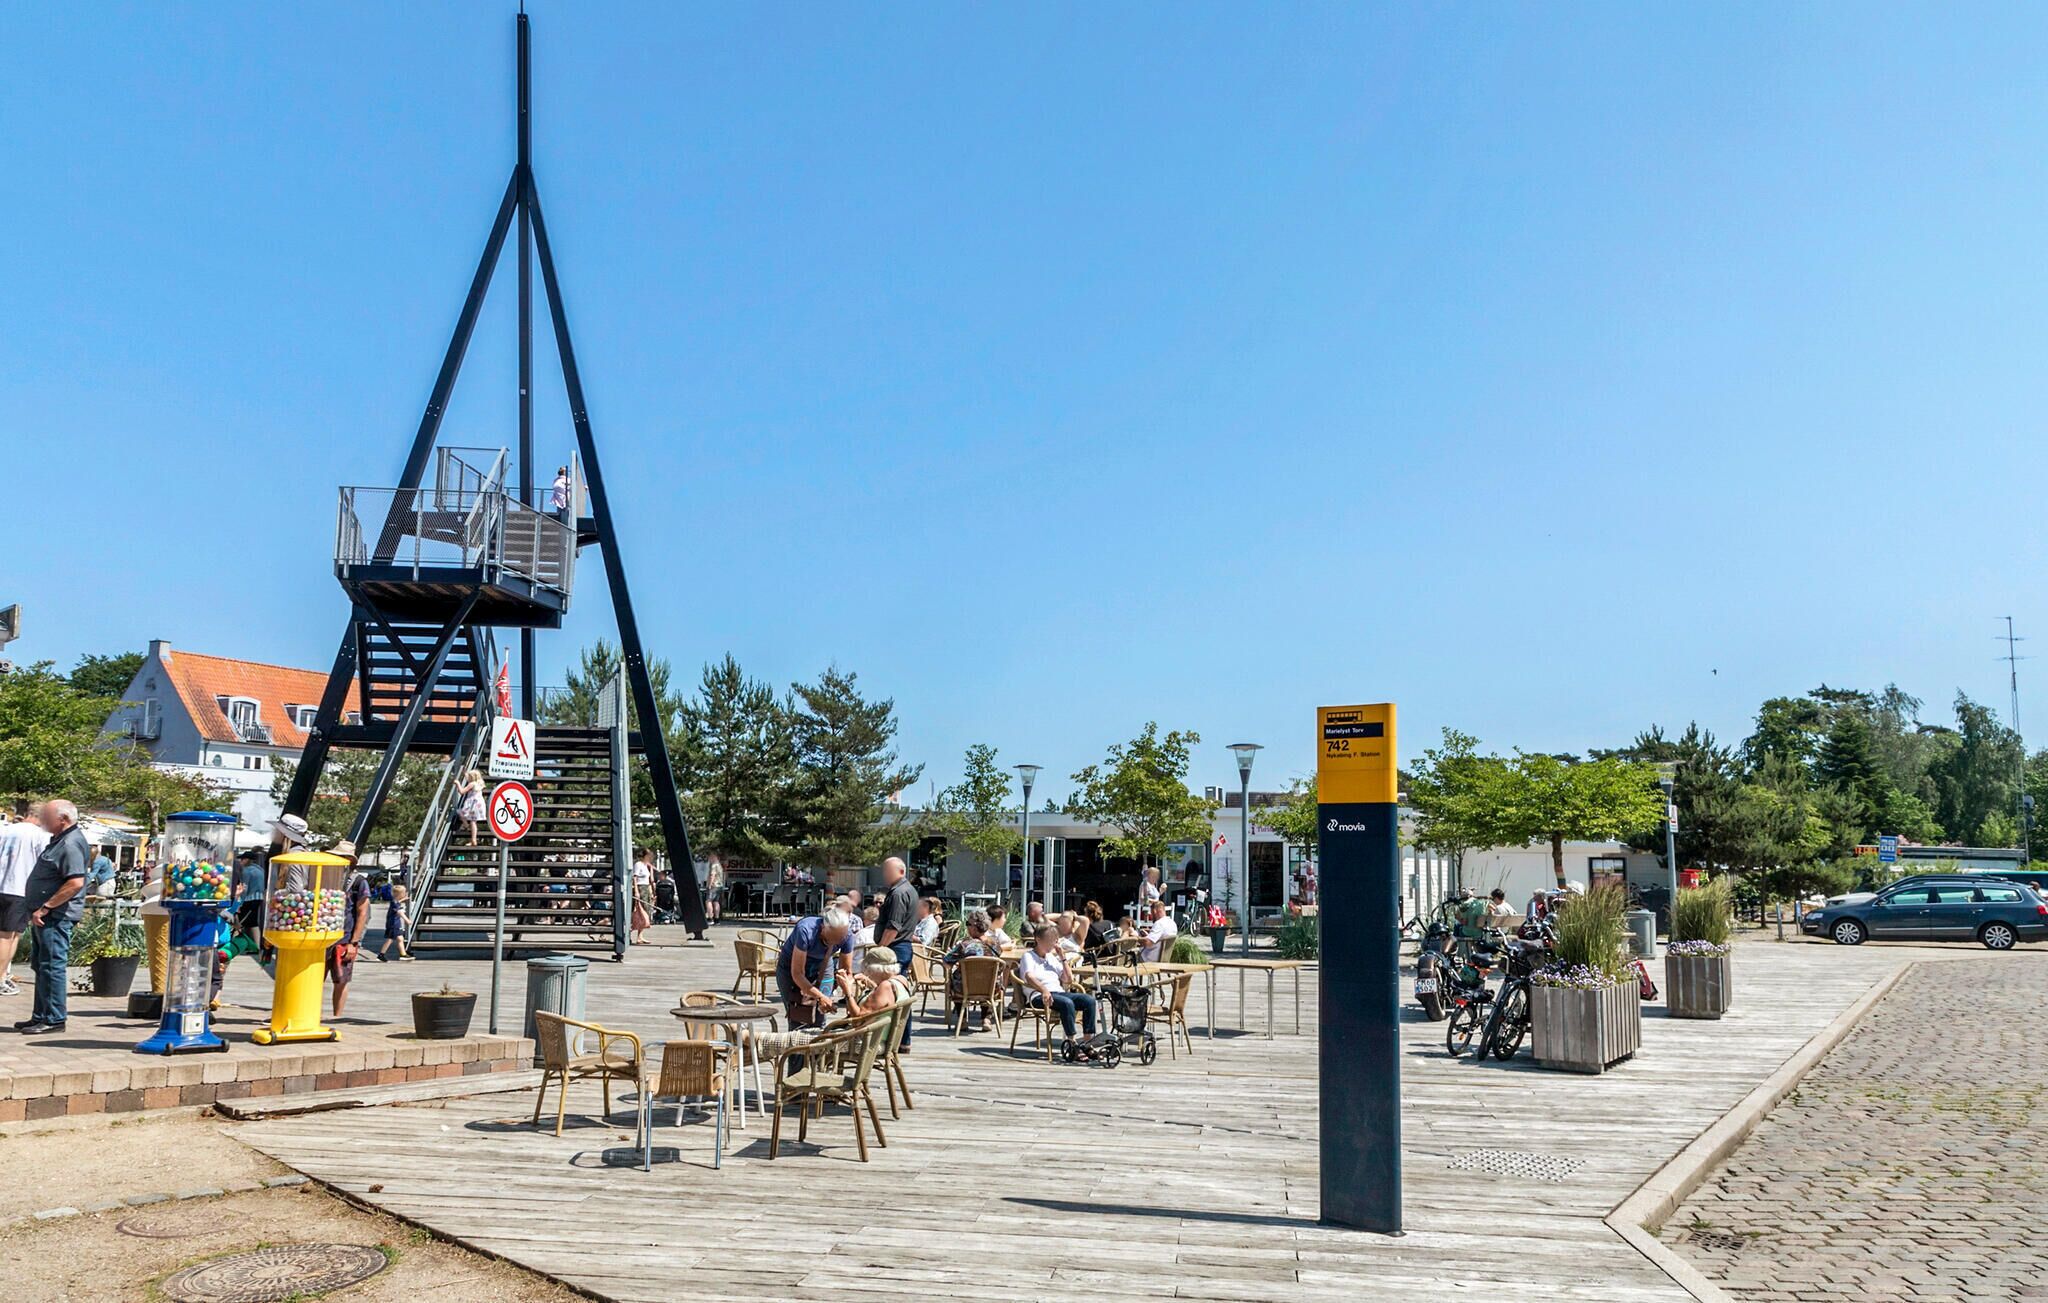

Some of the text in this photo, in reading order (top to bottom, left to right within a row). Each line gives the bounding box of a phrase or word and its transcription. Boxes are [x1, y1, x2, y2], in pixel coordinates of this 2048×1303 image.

[1325, 727, 1351, 735] Marielyst
[1326, 739, 1350, 752] 742
[516, 769, 532, 777] glatte
[1338, 821, 1366, 831] movia
